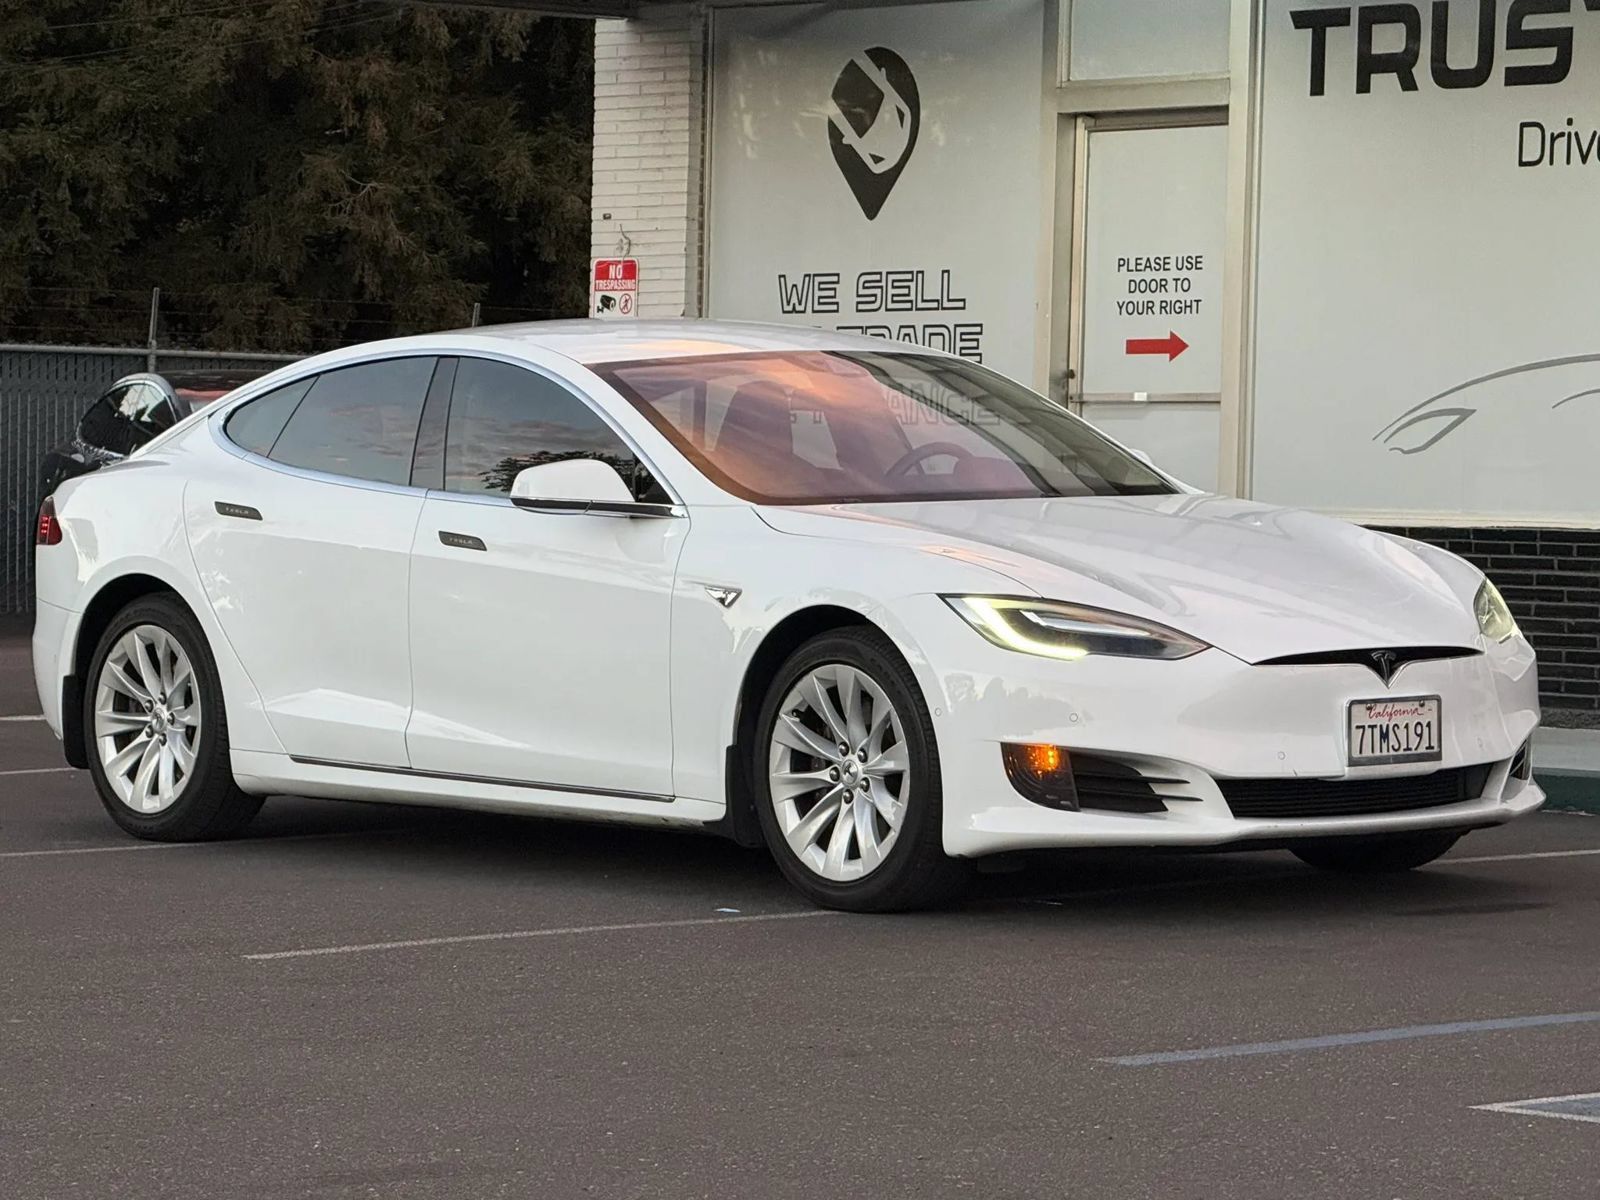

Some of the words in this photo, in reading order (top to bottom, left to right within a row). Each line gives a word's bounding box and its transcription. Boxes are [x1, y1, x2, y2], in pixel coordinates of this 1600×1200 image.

[1290, 0, 1600, 97] TRUS
[1518, 117, 1600, 168] Driv
[608, 264, 623, 279] NO
[1117, 256, 1171, 273] PLEASE
[1175, 255, 1203, 271] USE
[595, 280, 636, 290] TRESPASSING
[778, 273, 840, 314] WE
[856, 269, 966, 313] SELL
[1128, 278, 1168, 294] DOOR
[1172, 277, 1191, 292] TO
[1116, 300, 1155, 316] YOUR
[1159, 299, 1202, 315] RIGHT
[836, 323, 984, 365] ADE
[1368, 703, 1424, 722] California
[1355, 720, 1435, 755] 7TMS191
